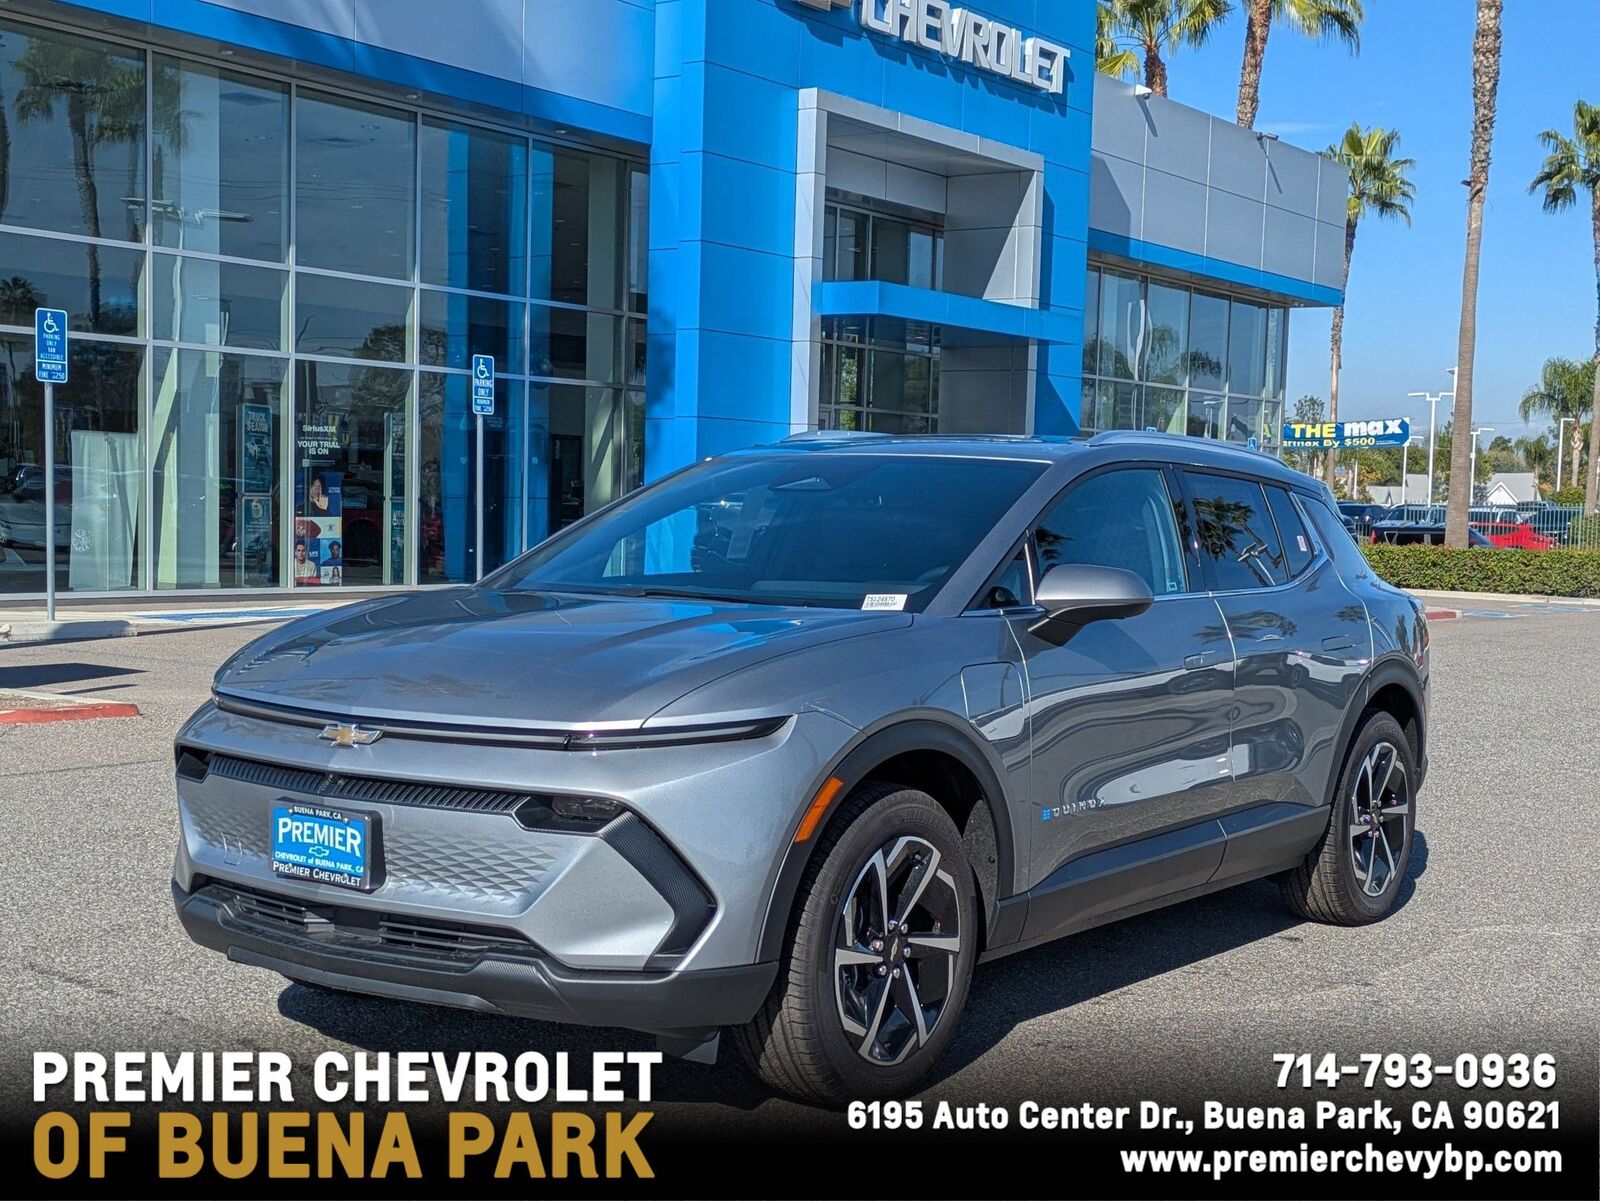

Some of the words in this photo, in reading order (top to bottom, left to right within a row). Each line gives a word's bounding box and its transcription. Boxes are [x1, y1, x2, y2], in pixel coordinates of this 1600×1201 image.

[859, 0, 1071, 94] CHEVROLET
[41, 363, 62, 371] MINIMUM
[474, 378, 493, 388] PARKING
[477, 388, 490, 396] ONLY
[302, 424, 336, 432] SiriusXM
[1290, 423, 1337, 438] THE
[1343, 419, 1403, 437] max
[297, 440, 318, 448] YOUR
[319, 440, 341, 449] TRIAL
[1323, 440, 1341, 448] By
[1344, 437, 1376, 447] $500
[308, 447, 317, 455] IS
[317, 447, 329, 455] ON
[293, 806, 314, 815] BUENA
[333, 812, 342, 820] CA
[278, 817, 361, 857] PREMIER
[274, 851, 307, 863] CHEVROLET
[314, 857, 335, 868] BUENA
[273, 861, 311, 877] PREMIER
[312, 868, 361, 887] CHEVROLET
